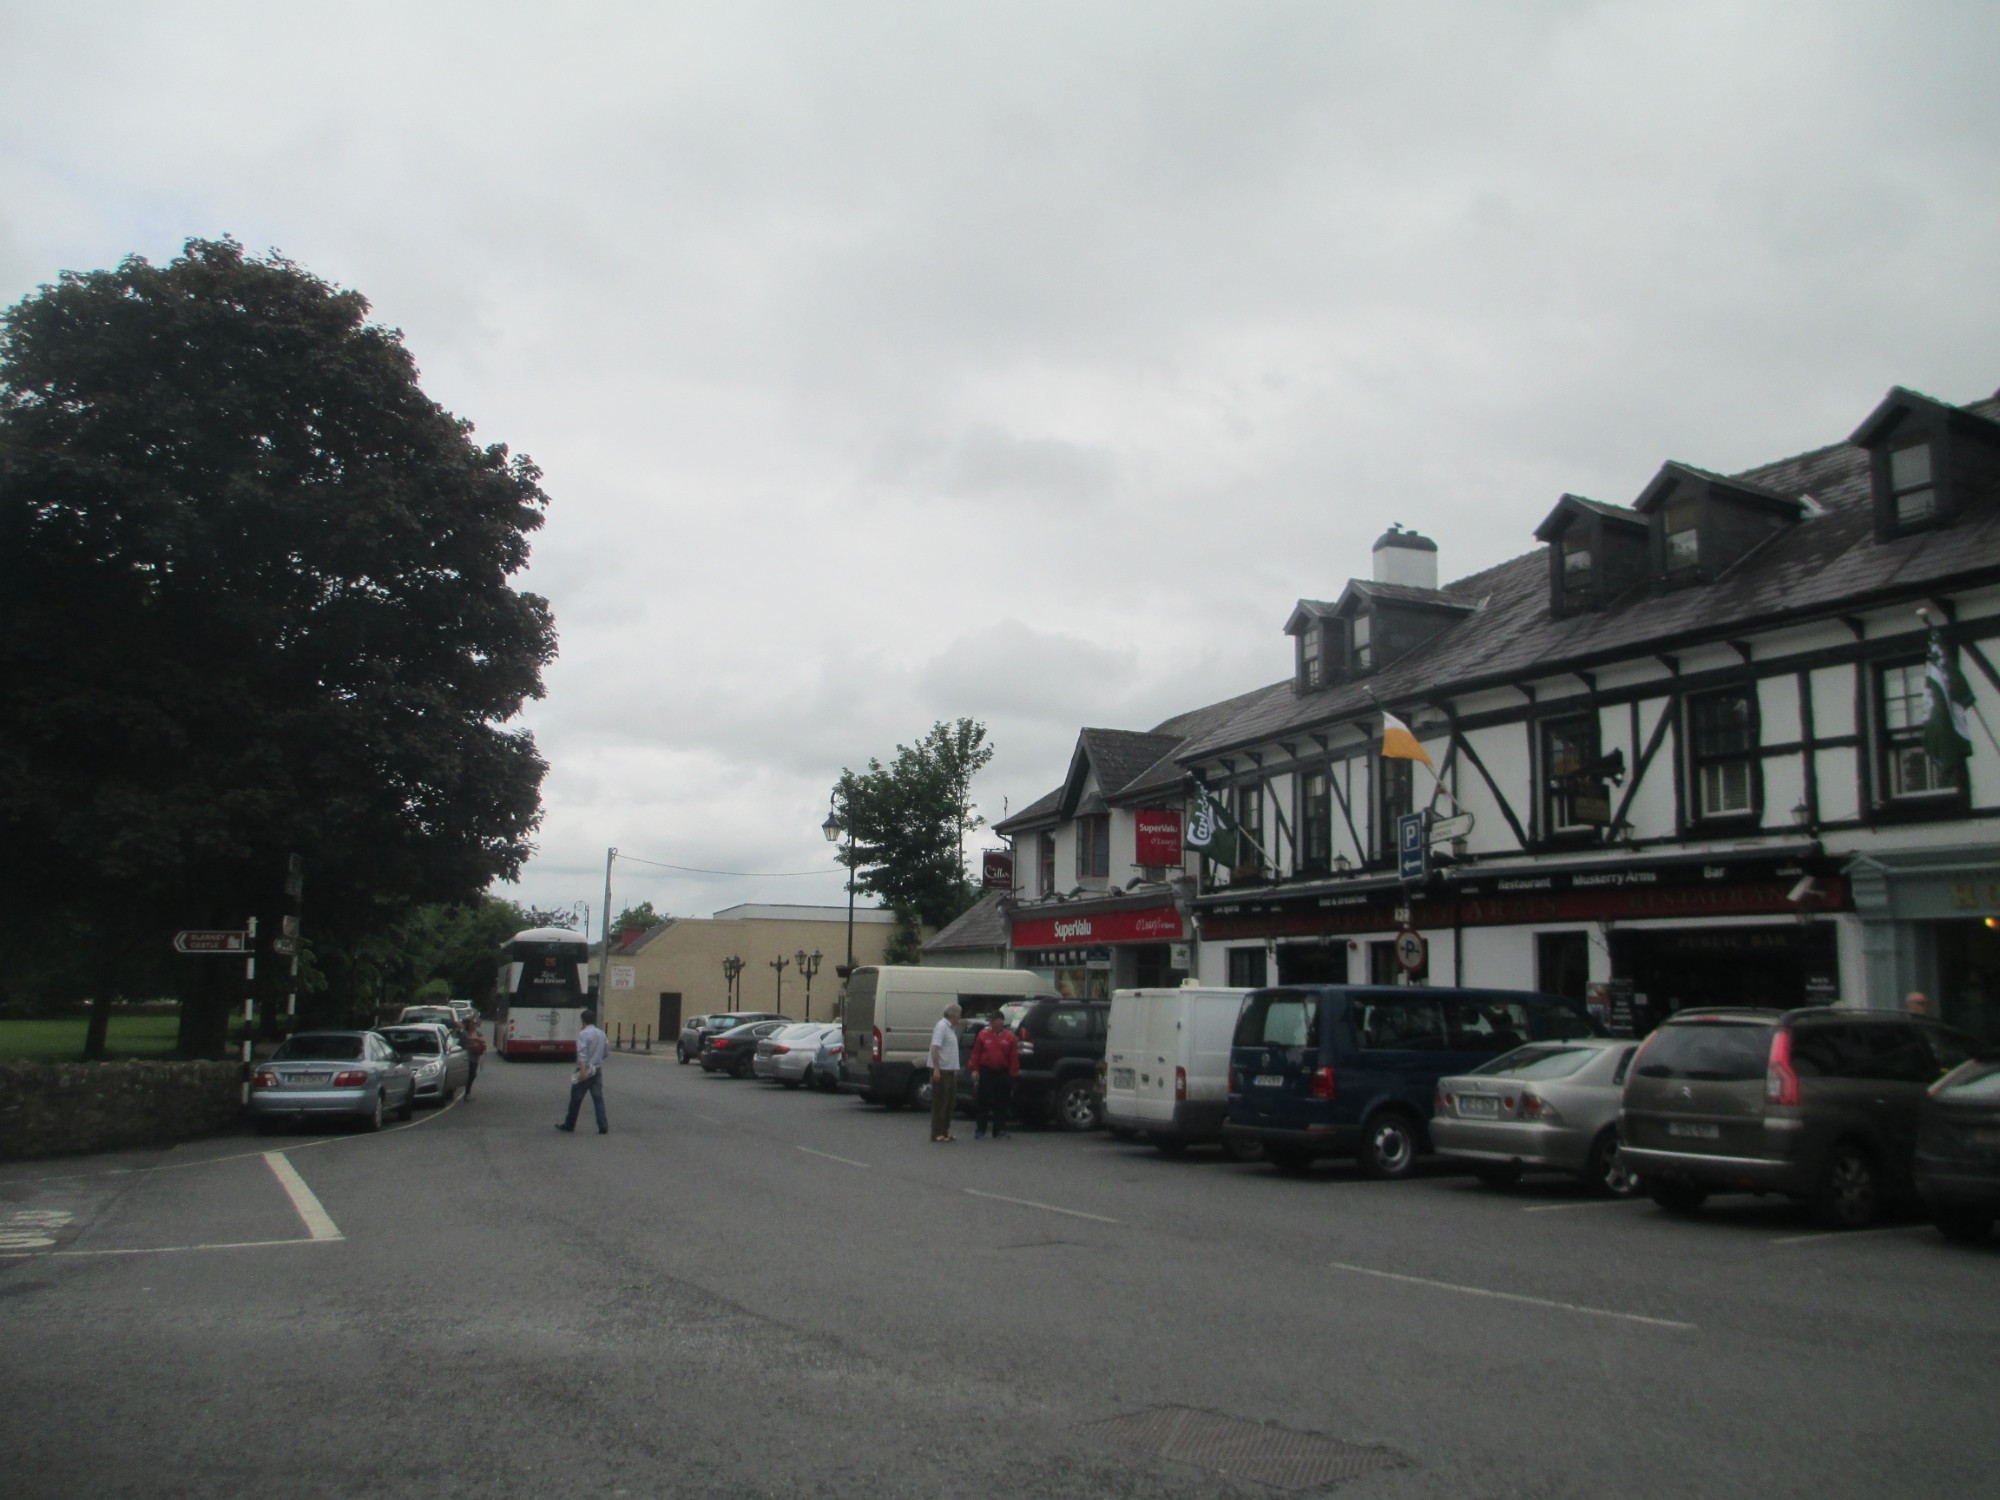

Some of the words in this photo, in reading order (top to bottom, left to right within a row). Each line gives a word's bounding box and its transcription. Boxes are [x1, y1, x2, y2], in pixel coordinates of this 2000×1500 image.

[1139, 824, 1178, 835] SuperValu
[1406, 825, 1416, 847] P
[1572, 874, 1625, 886] Muskerry
[1626, 870, 1657, 883] Arms
[1703, 866, 1727, 878] Bar
[1497, 877, 1552, 890] Restaurant
[1631, 884, 1788, 908] RESTAURAN
[1054, 918, 1092, 941] SuperValu
